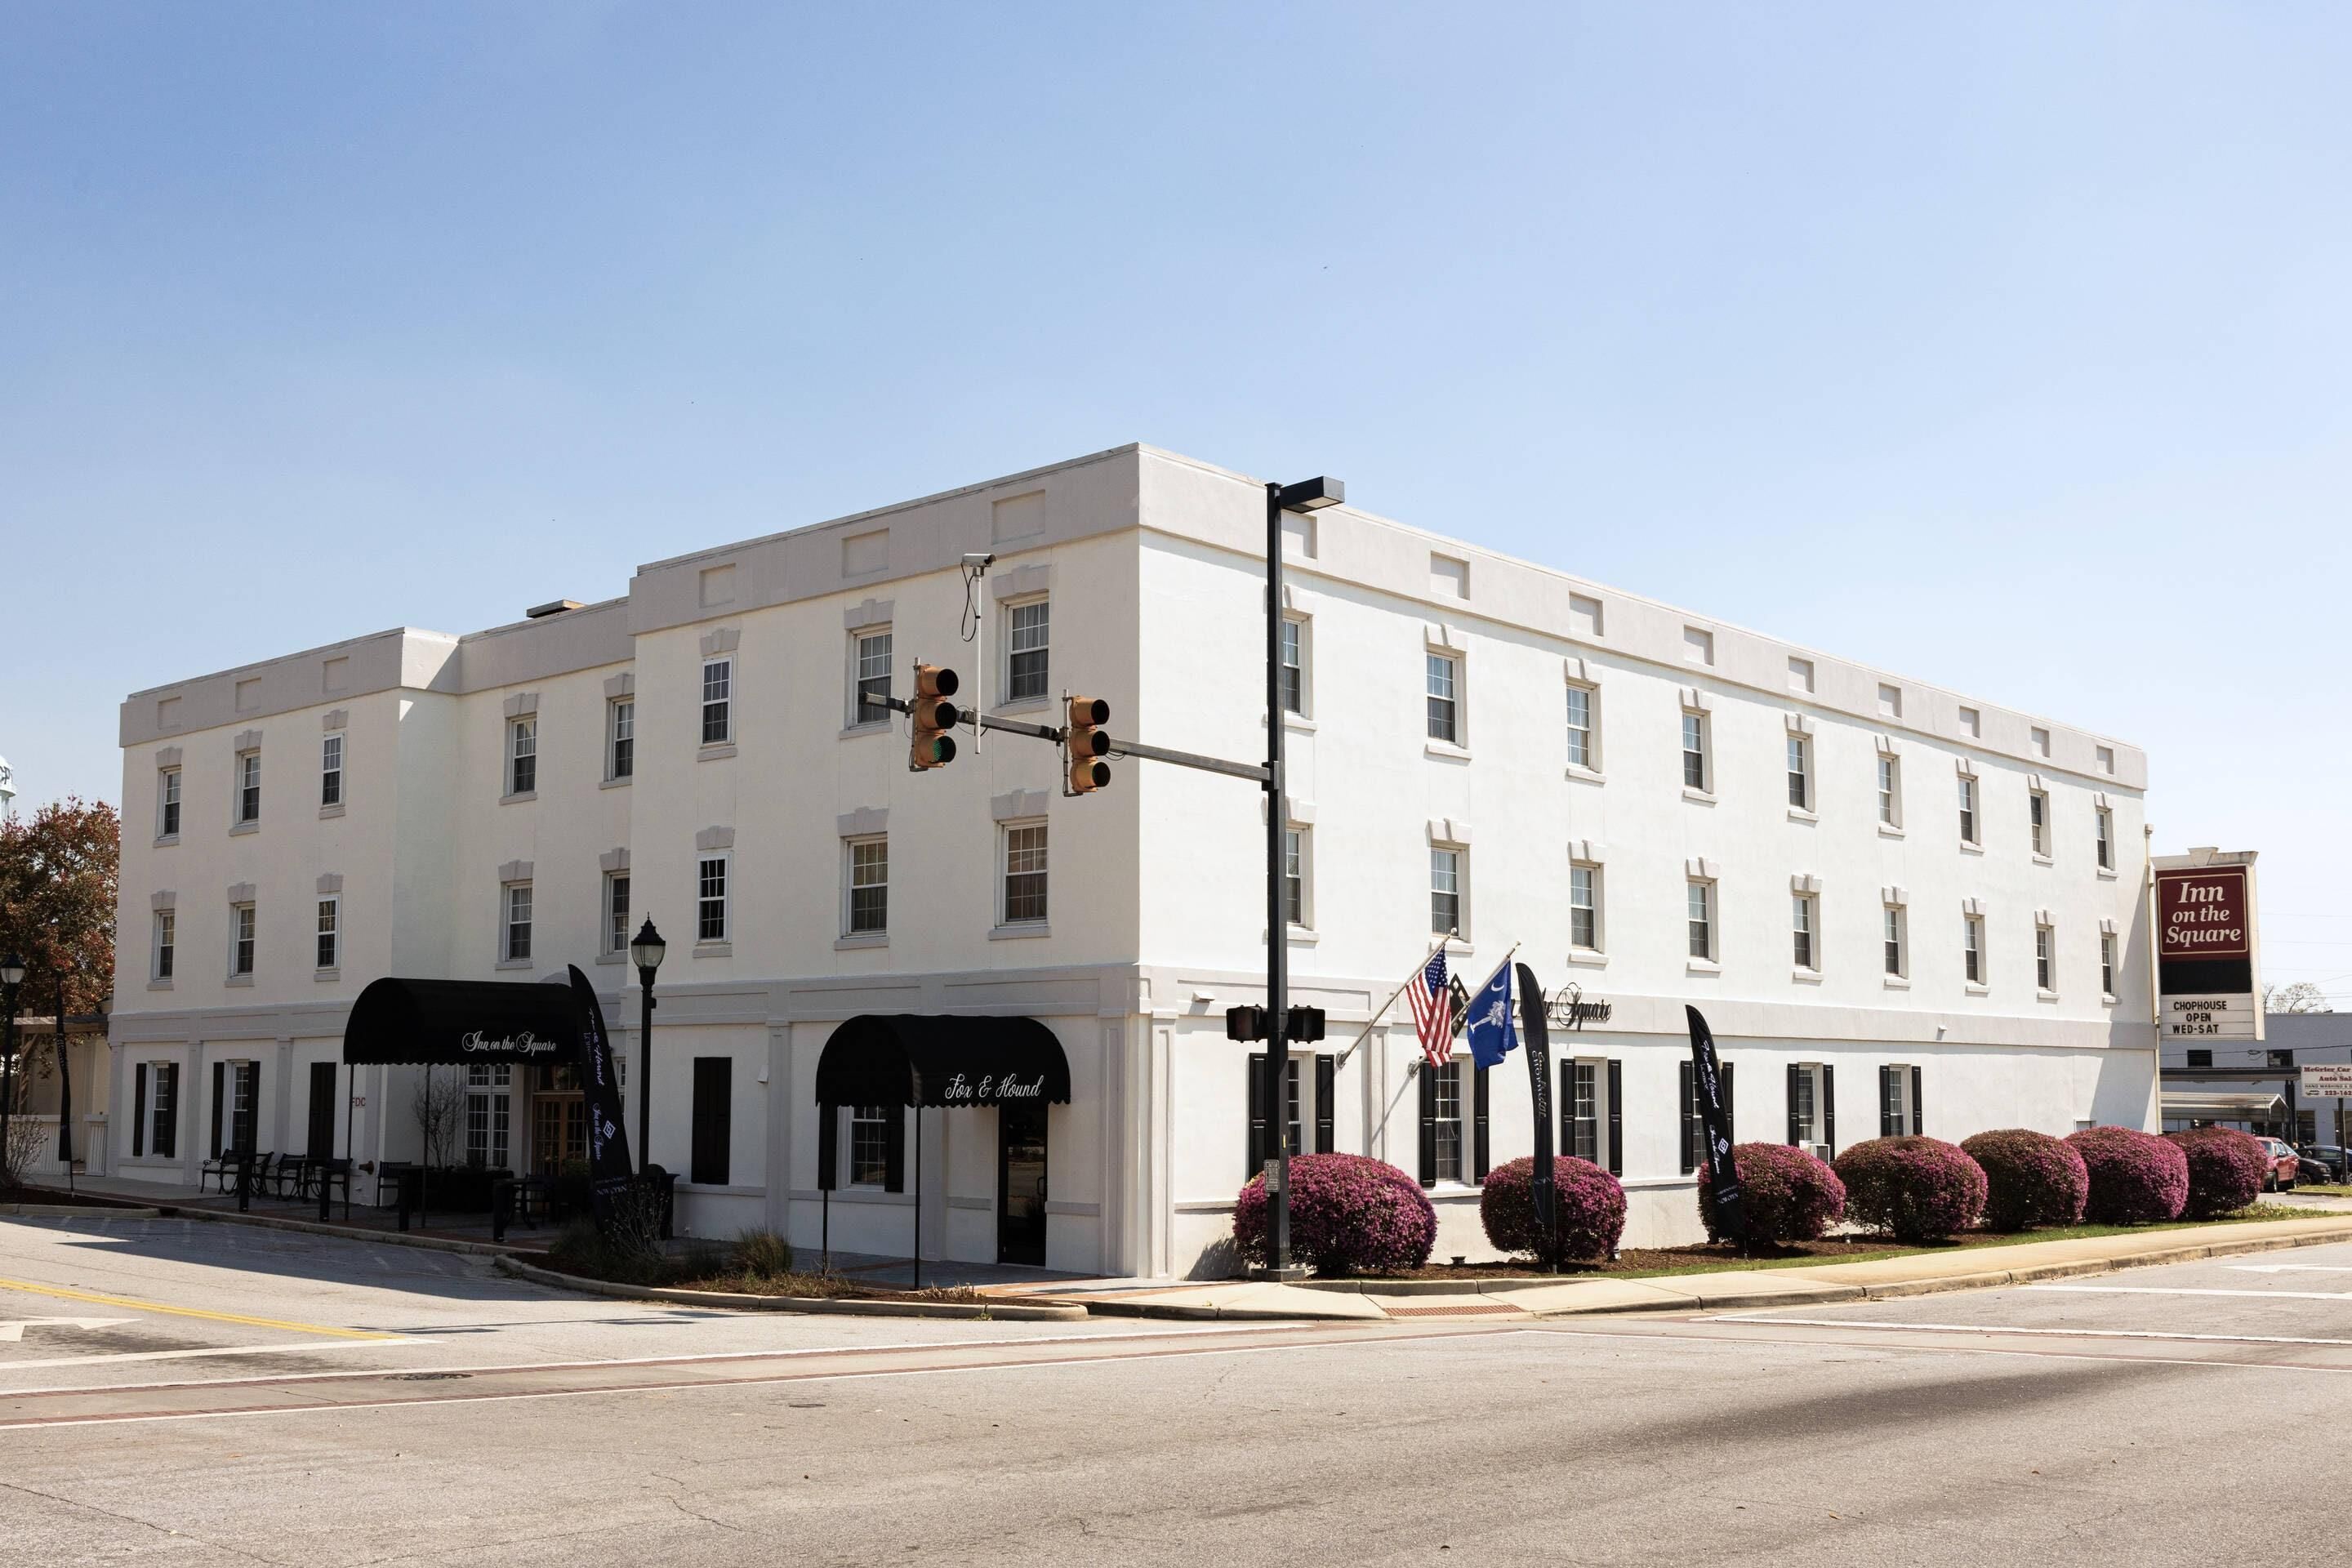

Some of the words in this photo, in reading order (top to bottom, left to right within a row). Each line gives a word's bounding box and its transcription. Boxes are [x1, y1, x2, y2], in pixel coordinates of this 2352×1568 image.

[2177, 882, 2225, 903] Inn
[2172, 911, 2196, 923] on
[2199, 905, 2230, 922] the
[2166, 926, 2241, 947] Square
[1557, 982, 1611, 1032] Square
[2173, 1000, 2227, 1010] CHOPHOUSE
[2185, 1013, 2212, 1022] OPEN
[2172, 1024, 2219, 1034] WED-SAT
[462, 1031, 490, 1052] Inn
[490, 1040, 501, 1050] on
[501, 1035, 515, 1050] the
[516, 1031, 556, 1057] Square
[945, 1073, 973, 1099] Fox
[978, 1075, 992, 1098] &
[996, 1073, 1044, 1098] Hound
